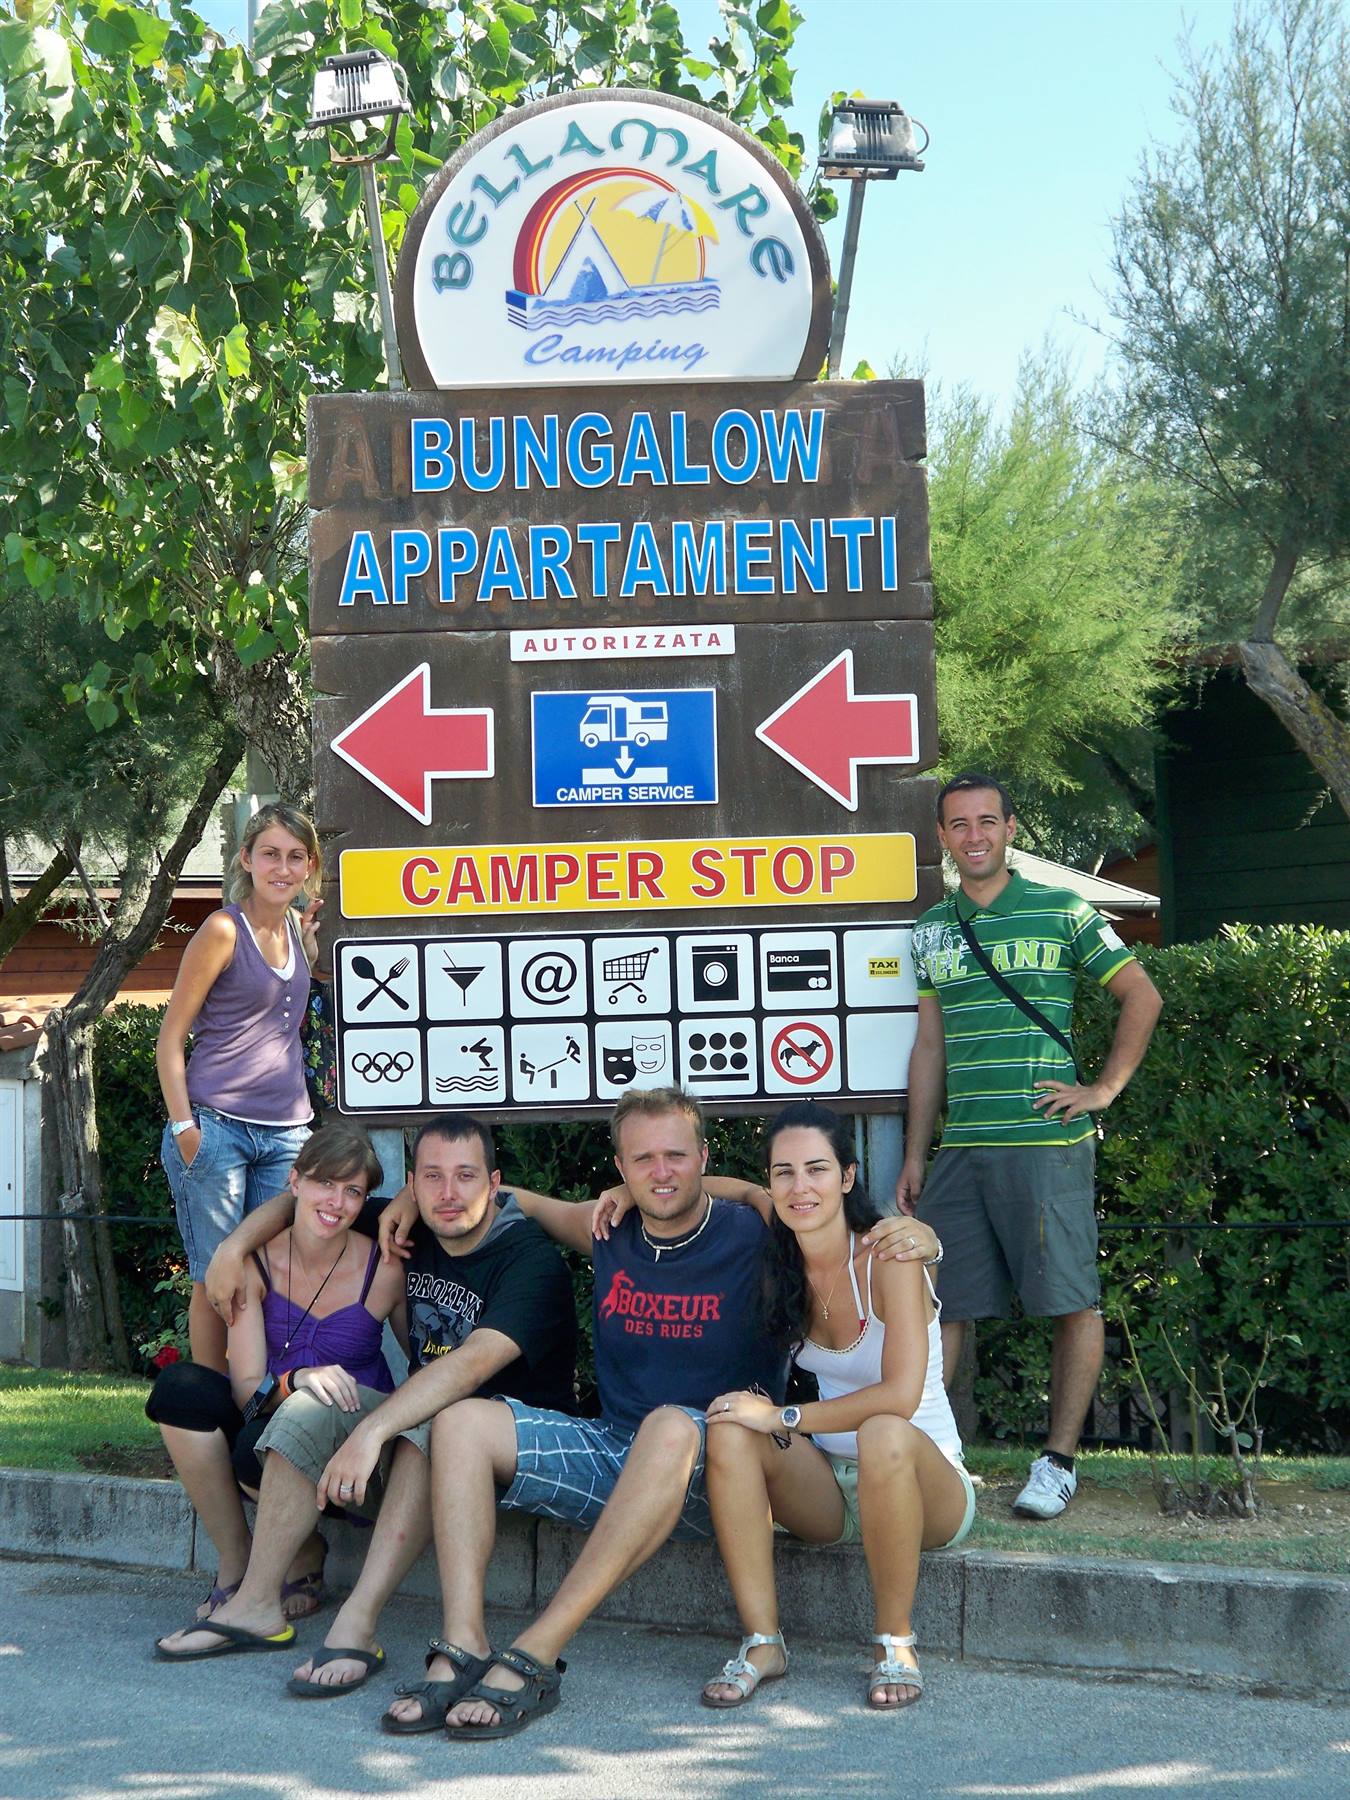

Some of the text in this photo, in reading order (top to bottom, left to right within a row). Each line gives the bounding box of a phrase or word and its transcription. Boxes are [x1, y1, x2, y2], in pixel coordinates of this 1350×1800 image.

[431, 118, 796, 295] BELLAMARE
[523, 333, 710, 373] Camping
[410, 408, 826, 493] BUNGALOW
[338, 516, 899, 607] APPARTAMENTI
[523, 632, 722, 653] AUTORIZZATA
[556, 785, 695, 802] CAMPER SERVICE
[400, 845, 857, 907] CAMPER STOP
[769, 954, 800, 963] Banca
[616, 1288, 721, 1321] BOXEUR
[624, 1319, 704, 1339] DES RUES
